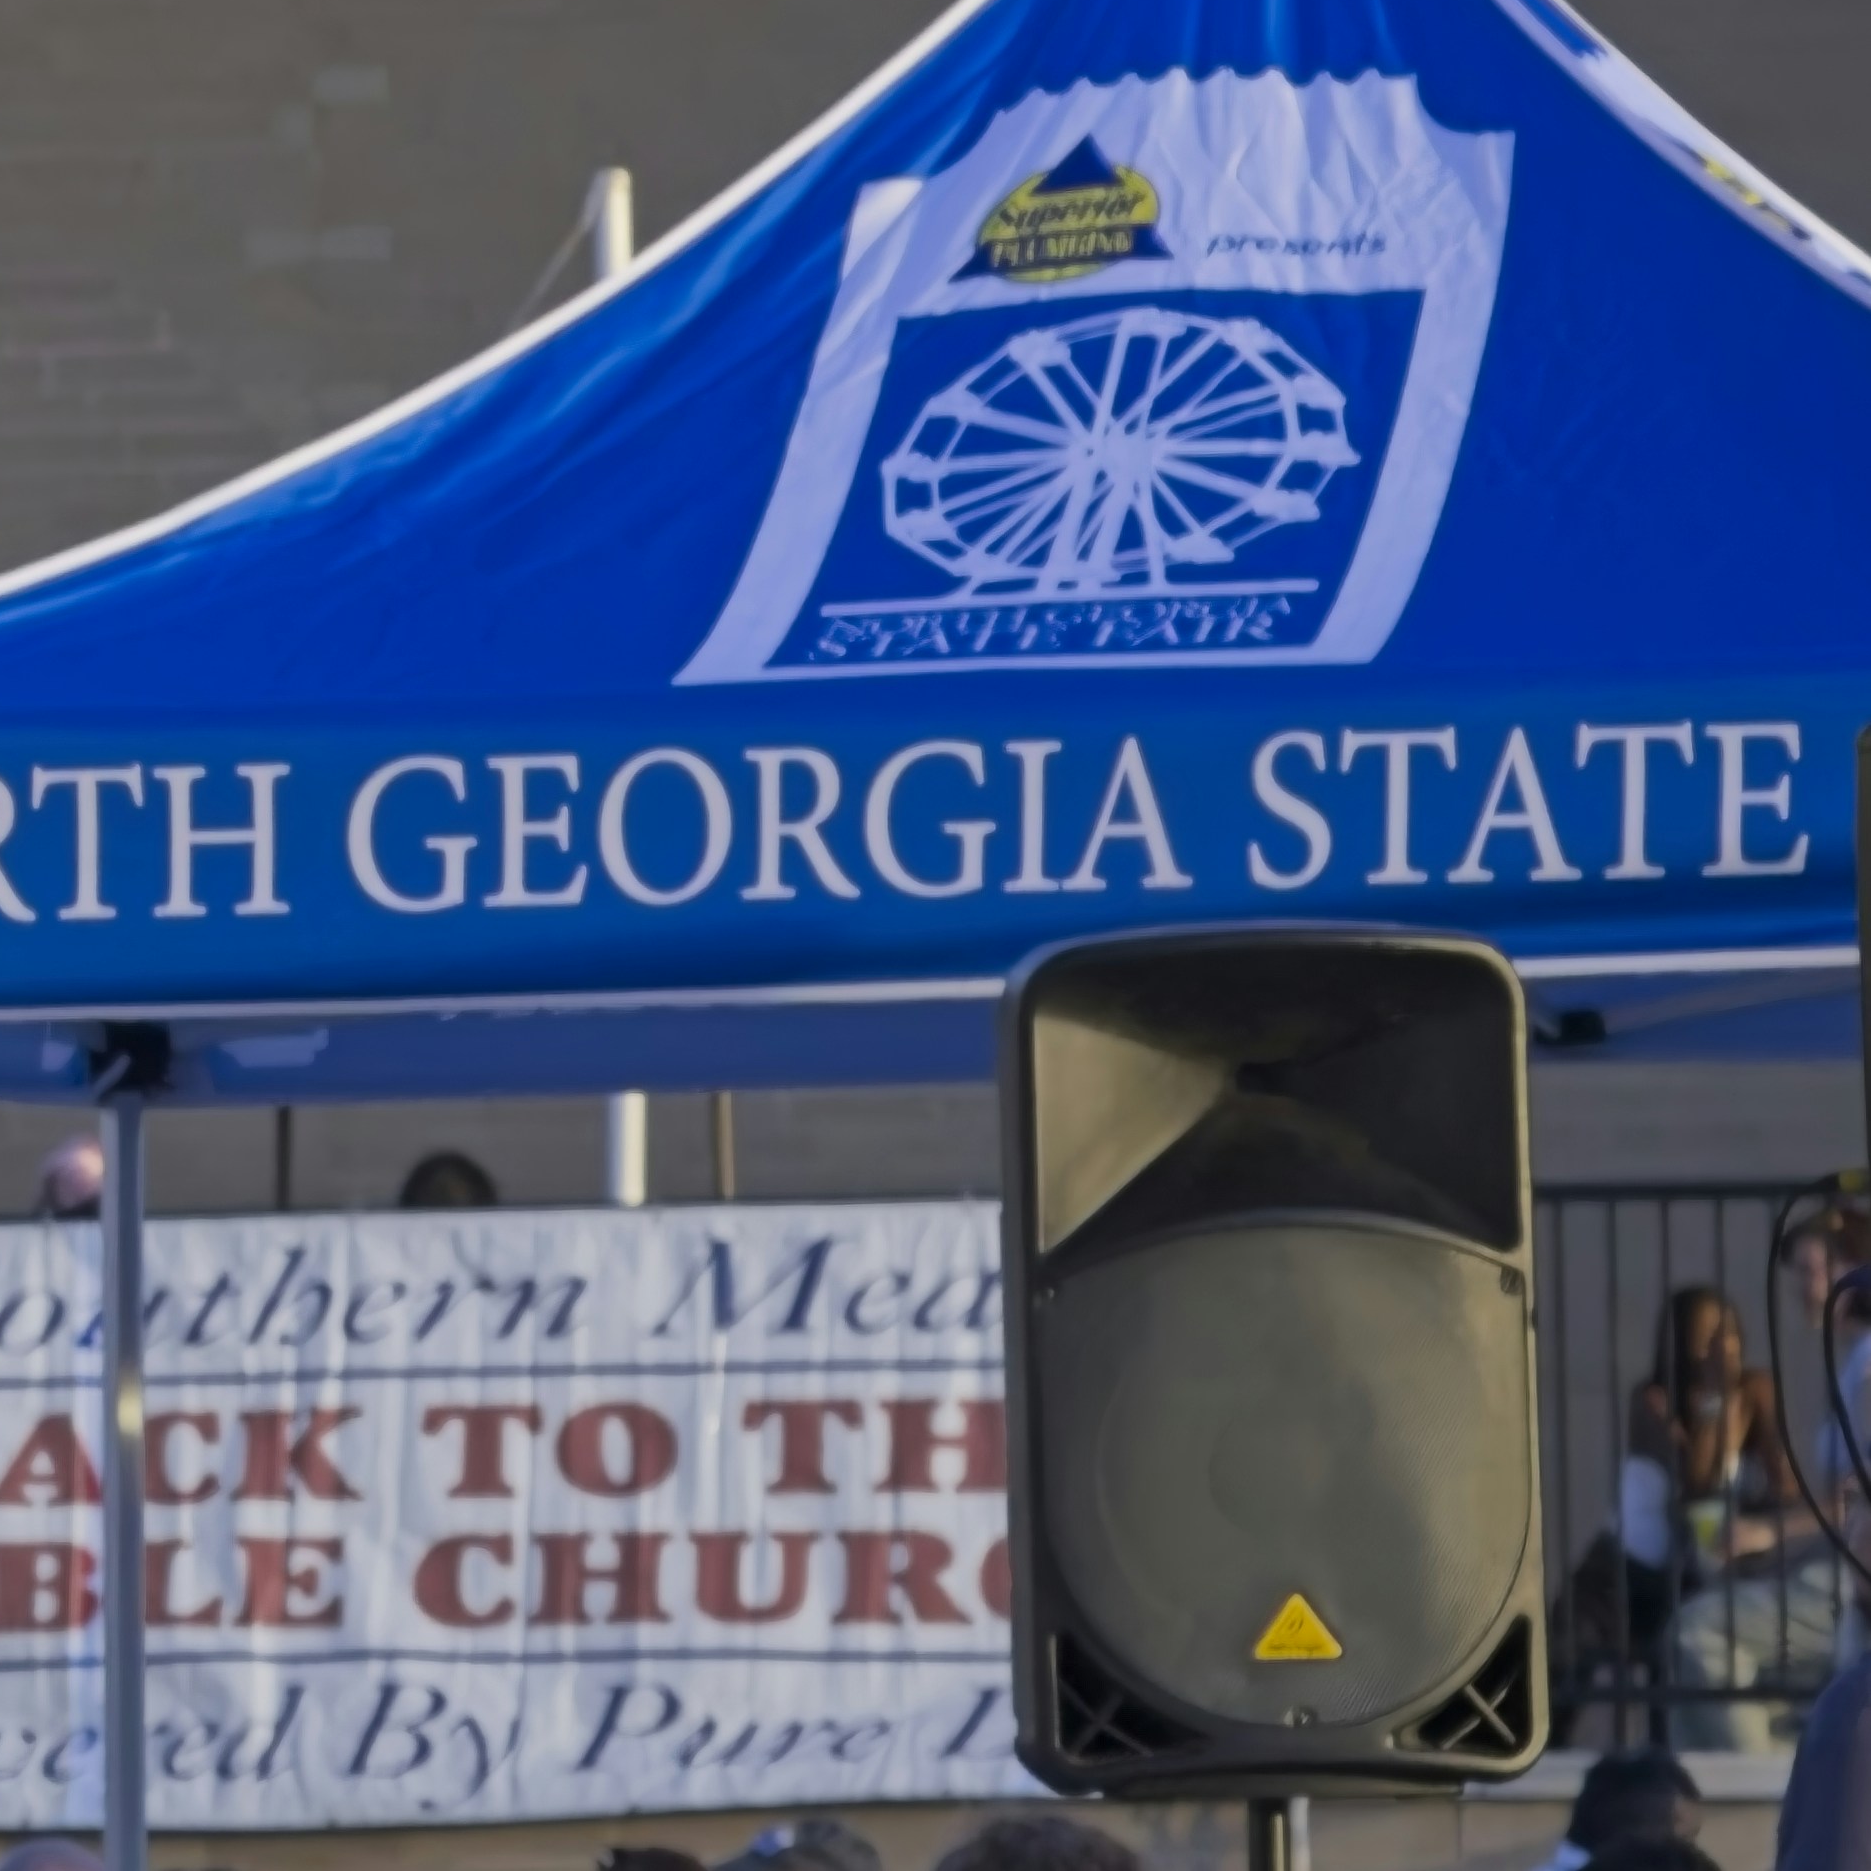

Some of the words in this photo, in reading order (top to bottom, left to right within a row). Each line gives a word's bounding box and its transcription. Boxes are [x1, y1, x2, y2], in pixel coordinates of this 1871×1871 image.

[1206, 230, 1387, 258] presents
[344, 735, 1195, 914] GEORGIA
[1248, 721, 1810, 890] STATE
[421, 1400, 680, 1500] TO
[347, 1681, 522, 1811] By
[572, 1681, 894, 1773] Pure
